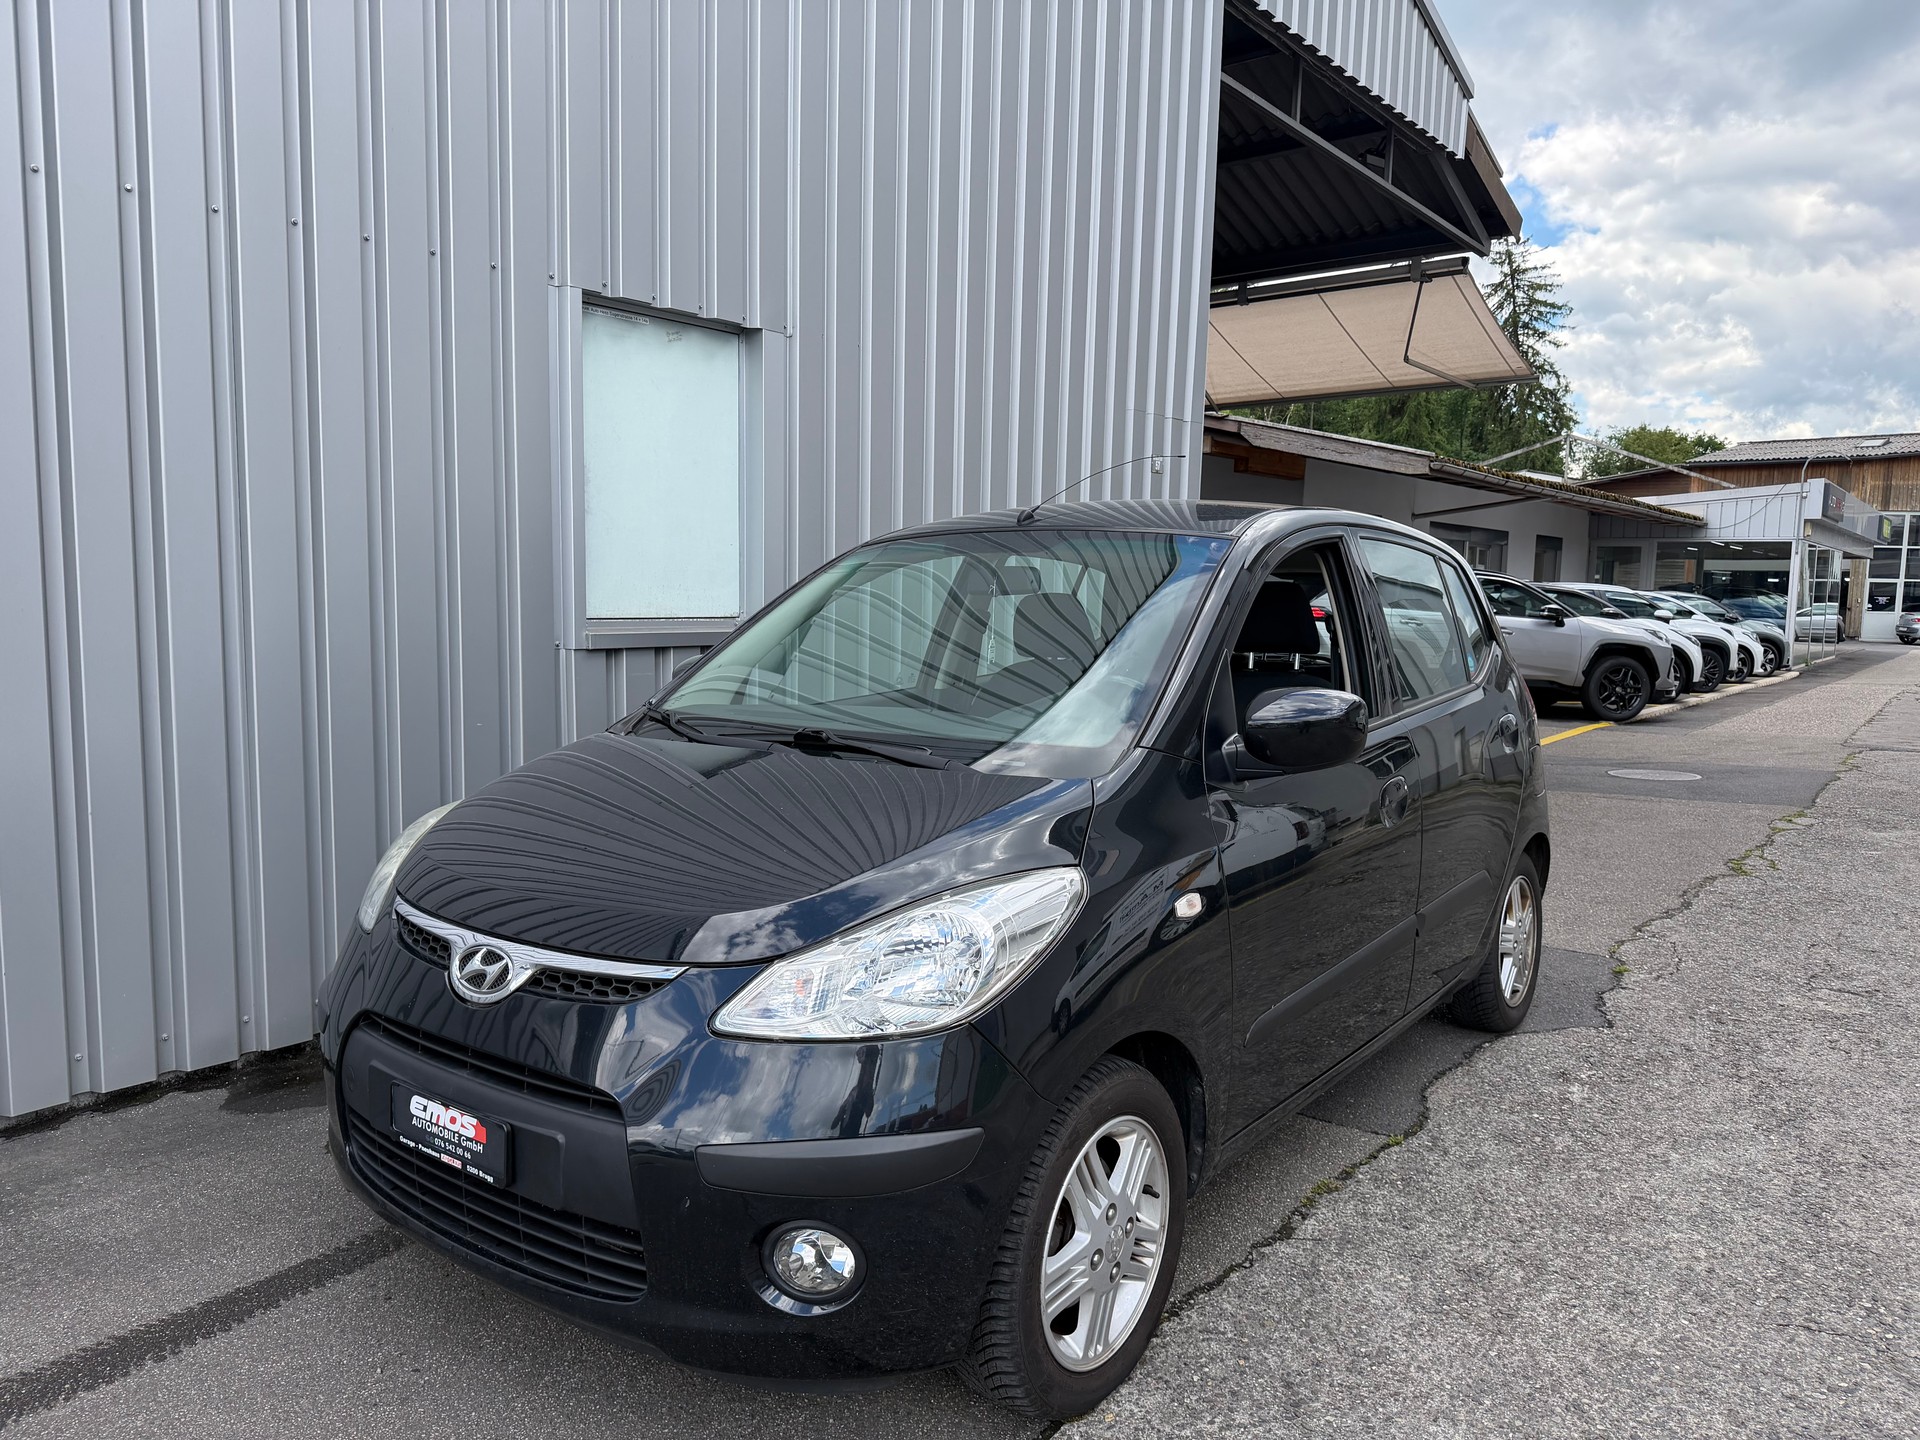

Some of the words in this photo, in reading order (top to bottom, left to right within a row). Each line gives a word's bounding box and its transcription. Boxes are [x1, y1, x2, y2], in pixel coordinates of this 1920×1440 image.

[411, 1116, 459, 1144] AUTOMOBILE
[460, 1136, 483, 1154] GmbH
[434, 1137, 444, 1148] 076
[446, 1142, 456, 1153] 542
[456, 1147, 463, 1156] 00
[464, 1151, 471, 1159] 66
[399, 1135, 416, 1148] Garage
[466, 1165, 478, 1175] 5200
[479, 1170, 494, 1183] Brugg
